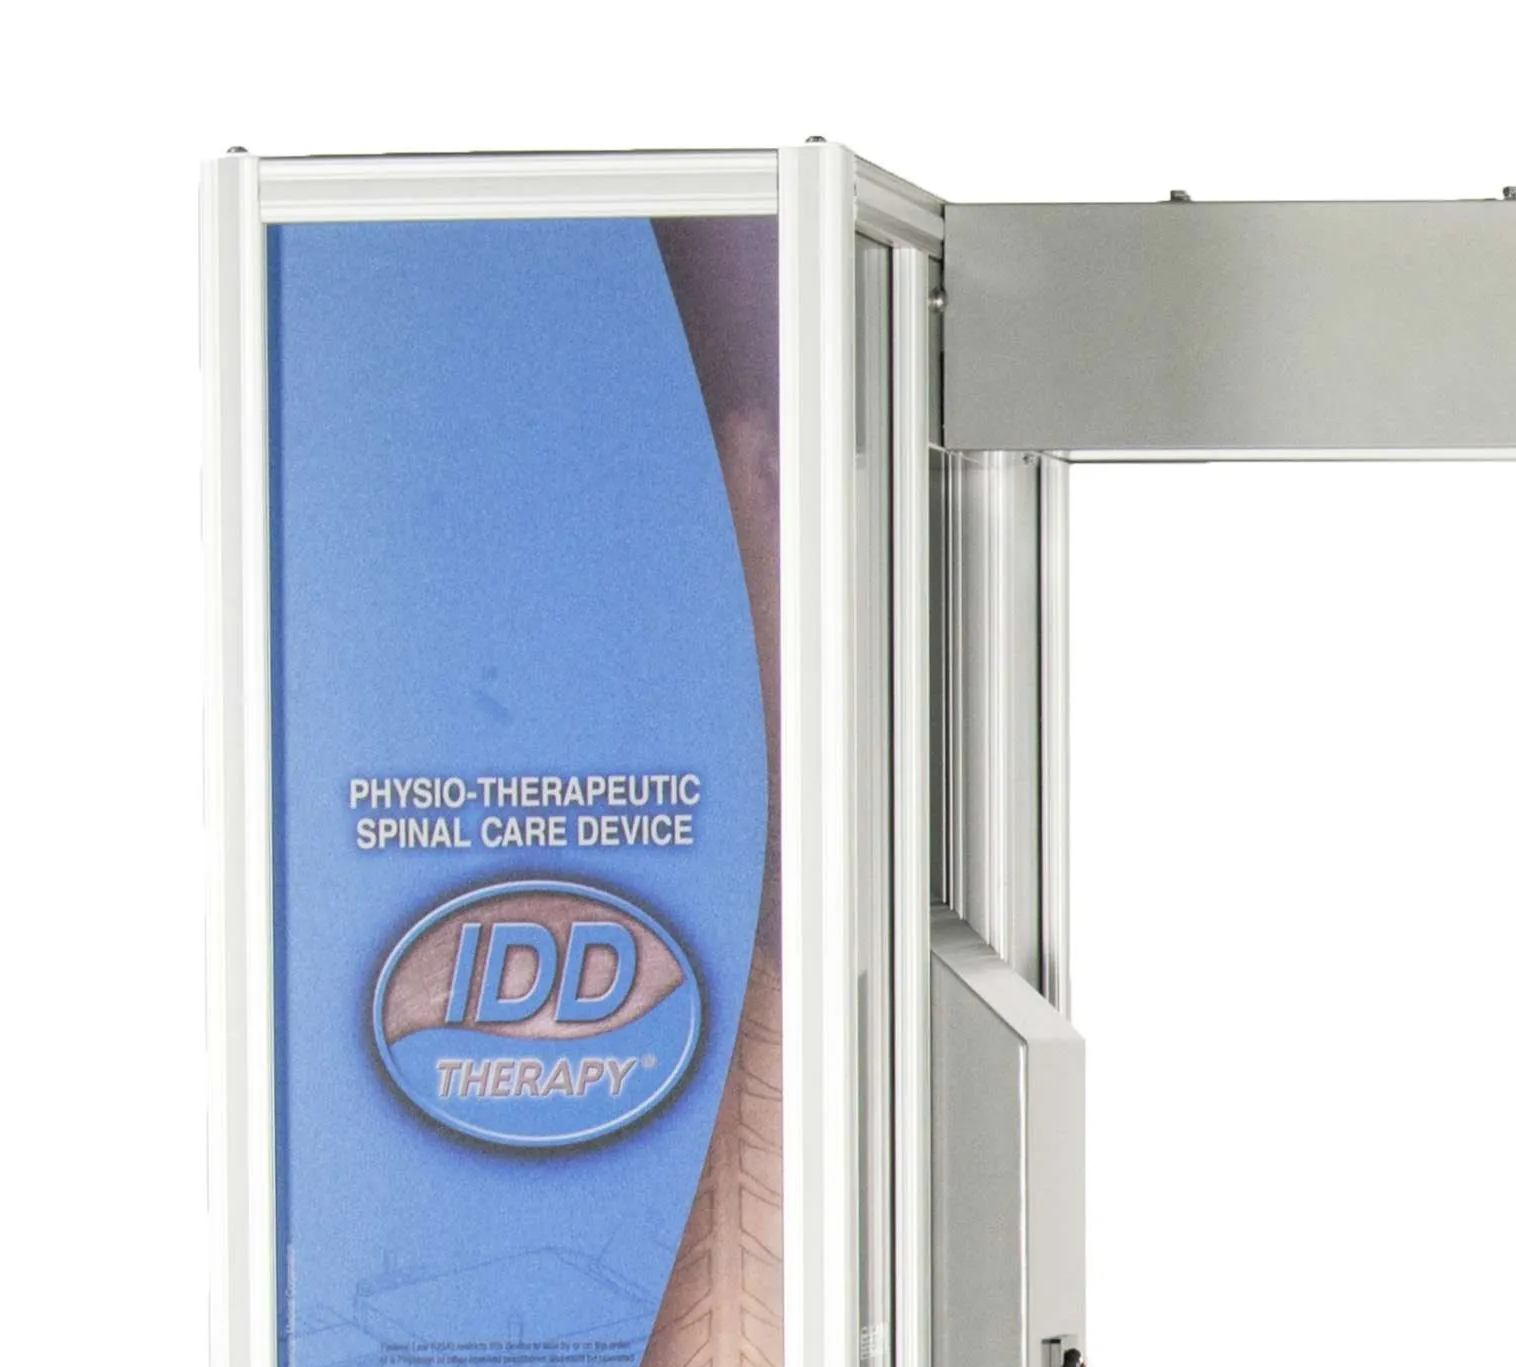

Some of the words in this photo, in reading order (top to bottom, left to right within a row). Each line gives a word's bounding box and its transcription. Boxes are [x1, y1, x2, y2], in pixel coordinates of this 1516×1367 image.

[350, 774, 701, 809] PHYSIO-THERAPEUTIC
[356, 816, 471, 849] SPINAL
[481, 816, 567, 847] CARE
[577, 815, 694, 846] DEVICE
[444, 920, 638, 1025] IDD
